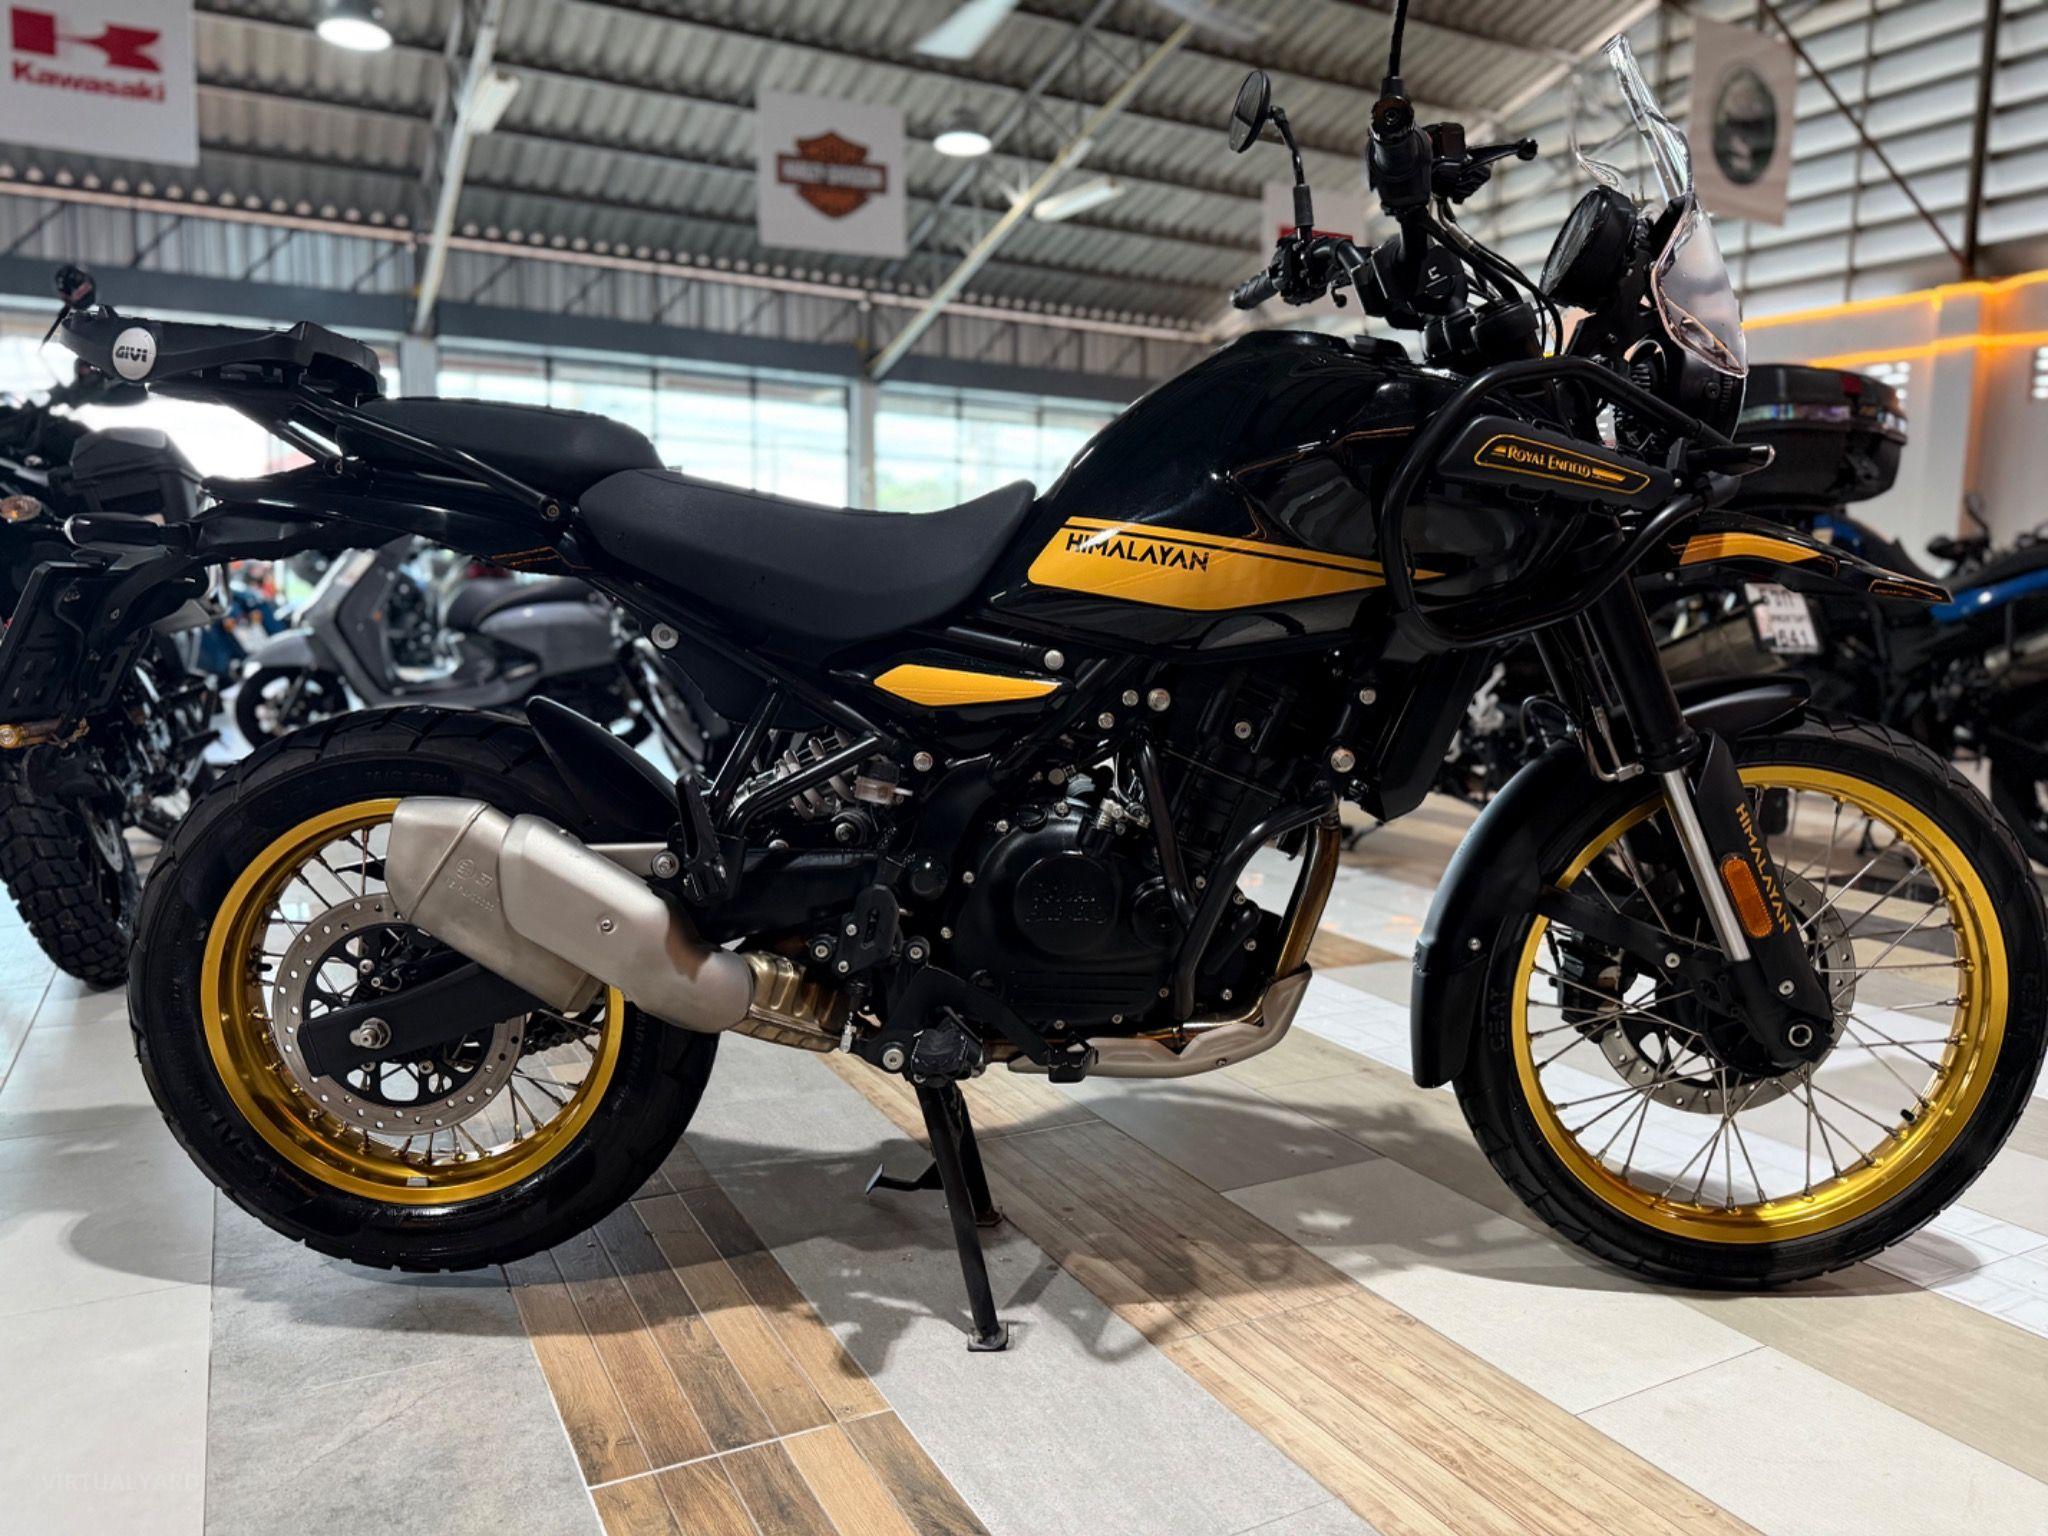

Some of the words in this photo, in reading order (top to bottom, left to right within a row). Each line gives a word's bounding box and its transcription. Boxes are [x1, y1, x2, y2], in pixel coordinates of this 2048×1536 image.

[12, 59, 165, 103] Kawasaki
[115, 345, 148, 362] GIVI
[1507, 445, 1545, 466] ROYAL
[1548, 454, 1591, 478] ENFIELD
[1065, 532, 1210, 572] HIMALAYAN
[1736, 802, 1791, 933] HIMALAYAN
